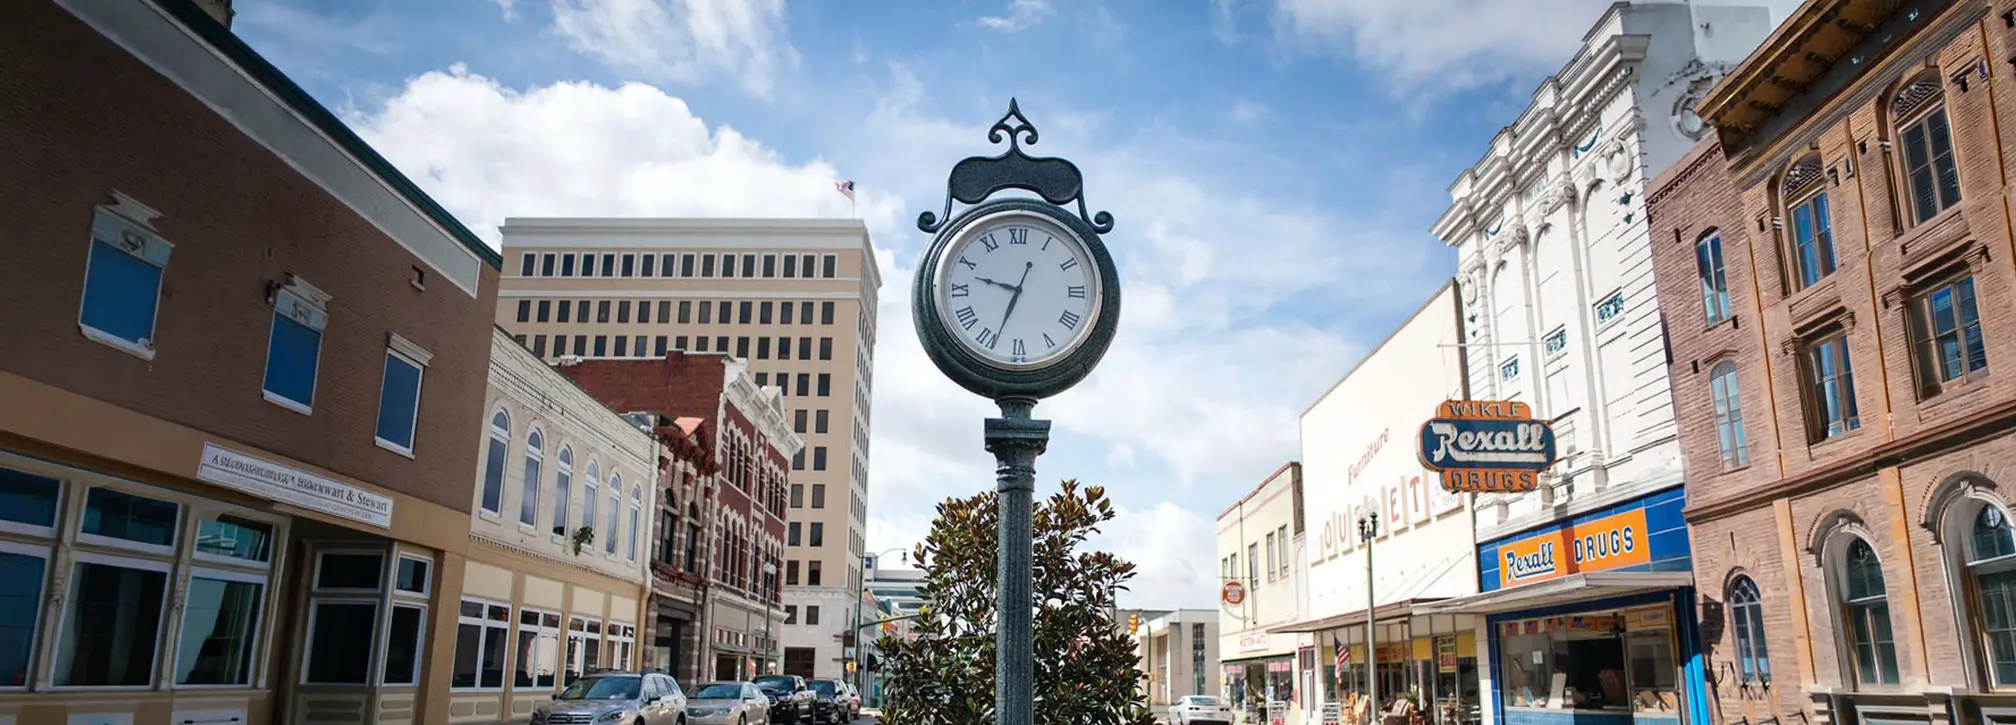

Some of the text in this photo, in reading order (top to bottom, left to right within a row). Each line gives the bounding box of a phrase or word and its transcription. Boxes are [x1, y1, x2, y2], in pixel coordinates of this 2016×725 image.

[979, 233, 1000, 253] XI
[1009, 229, 1028, 245] XII
[1041, 237, 1052, 252] I
[959, 256, 977, 270] X
[1060, 257, 1078, 272] II
[952, 283, 969, 298] IX
[1068, 285, 1085, 299] III
[956, 305, 979, 331] VIII
[1058, 310, 1080, 331] IIII
[1012, 339, 1026, 356] VI
[1043, 332, 1056, 349] V
[1448, 402, 1524, 418] WIKLE
[1431, 421, 1547, 463] Rexall
[1347, 428, 1390, 486] Furniture
[1451, 471, 1533, 489] DRUGS
[346, 490, 355, 502] &
[357, 491, 388, 512] Stewart
[1506, 526, 1634, 581] Rexall DRUGS
